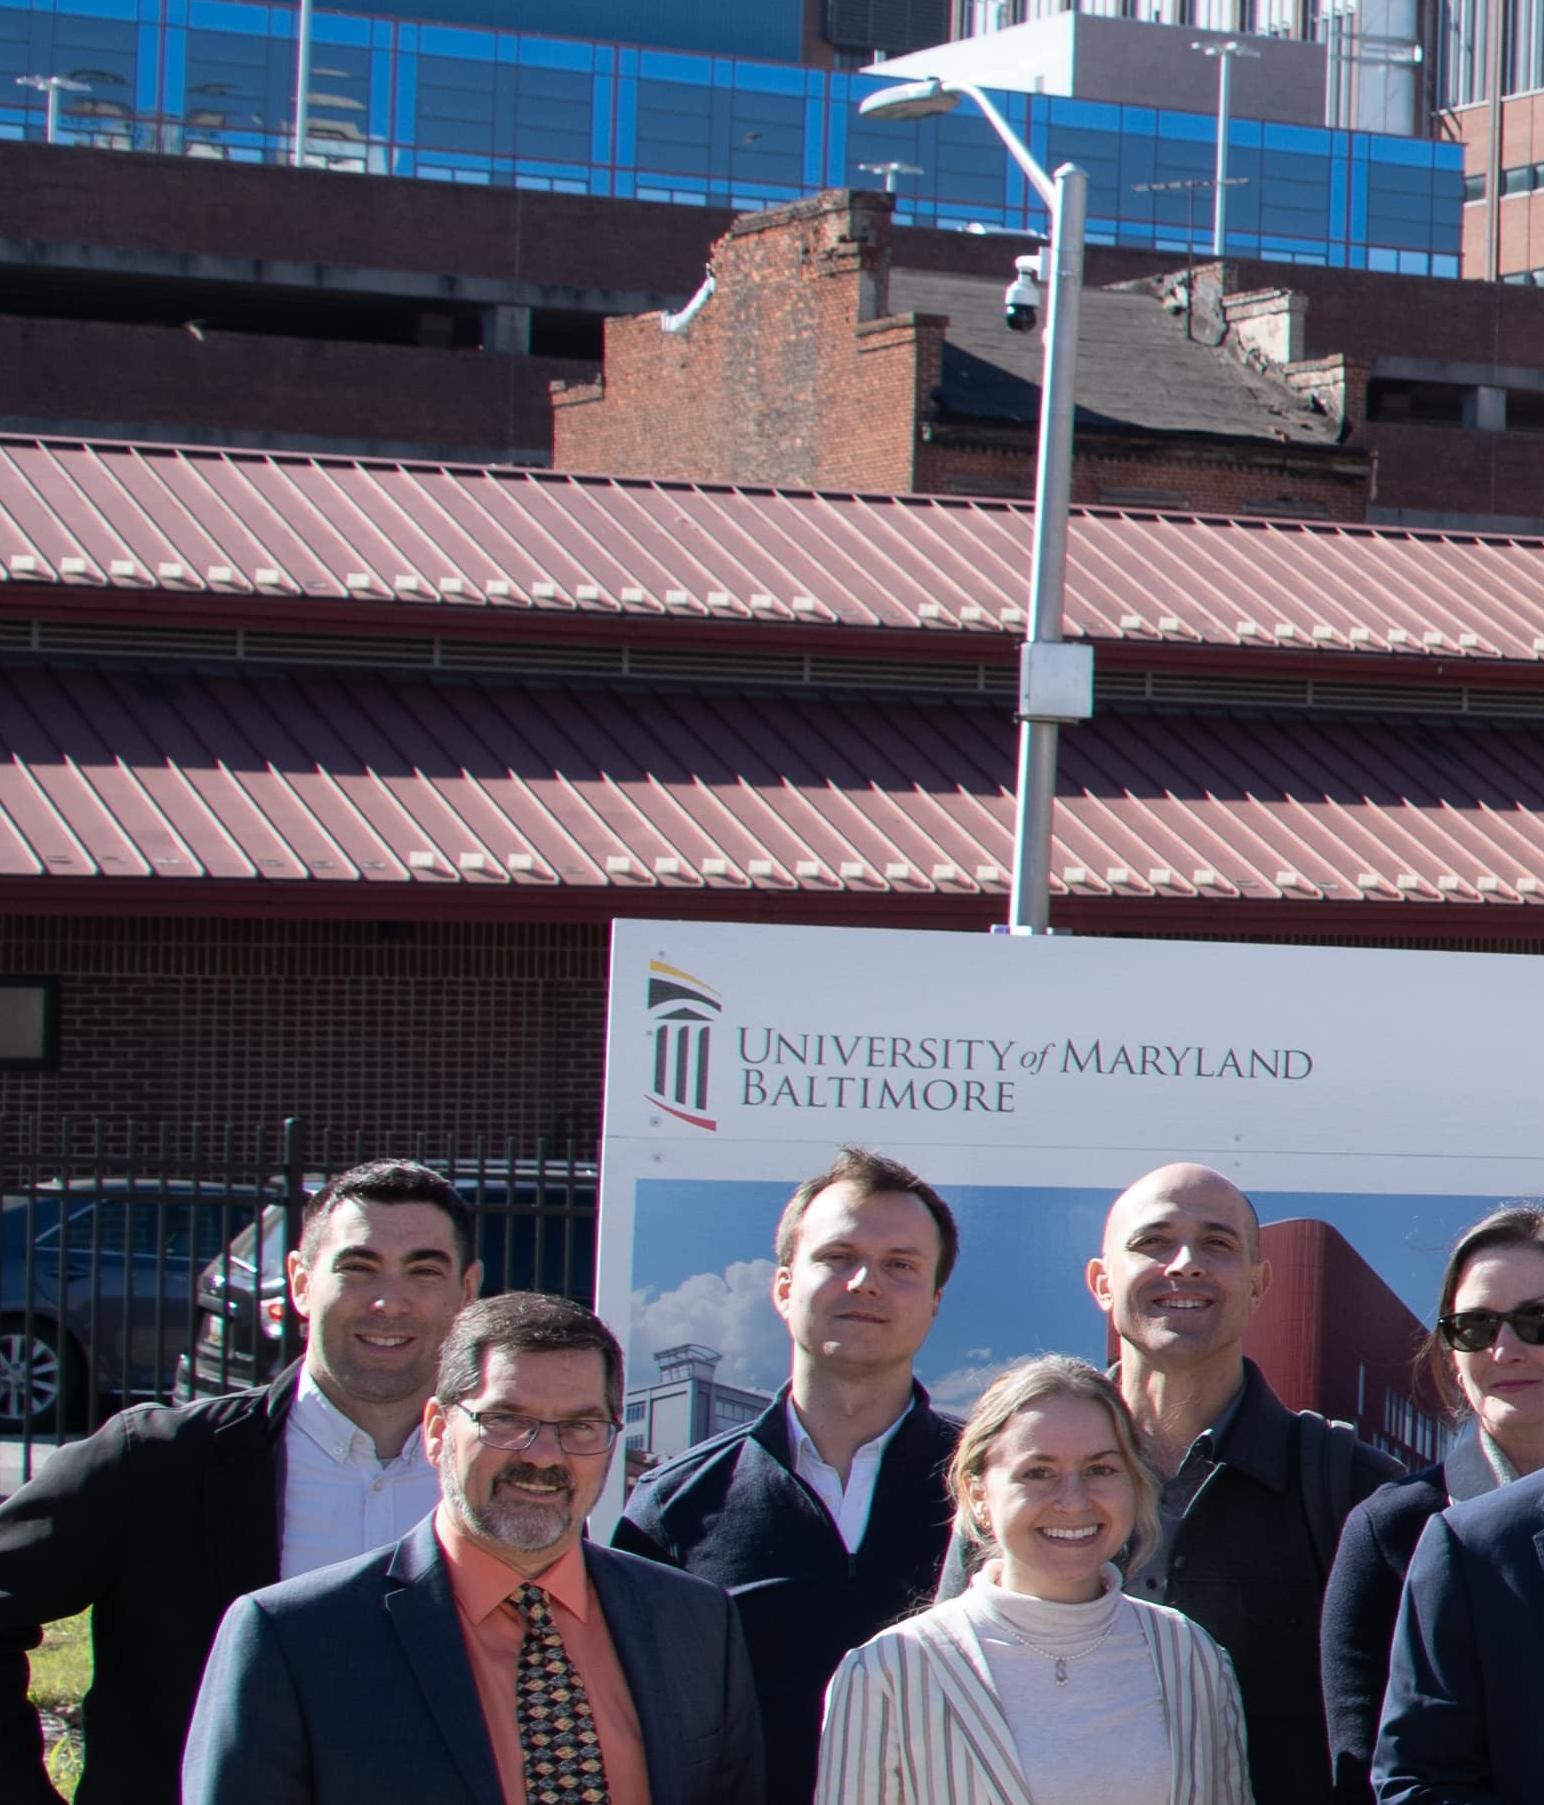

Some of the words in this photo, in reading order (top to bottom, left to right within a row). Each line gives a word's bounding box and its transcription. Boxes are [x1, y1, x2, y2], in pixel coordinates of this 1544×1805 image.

[736, 1026, 1016, 1071] UNIVERSITY
[1019, 1043, 1056, 1075] of
[1062, 1038, 1314, 1081] MARYLAND
[741, 1068, 1017, 1113] BALTIMORE
